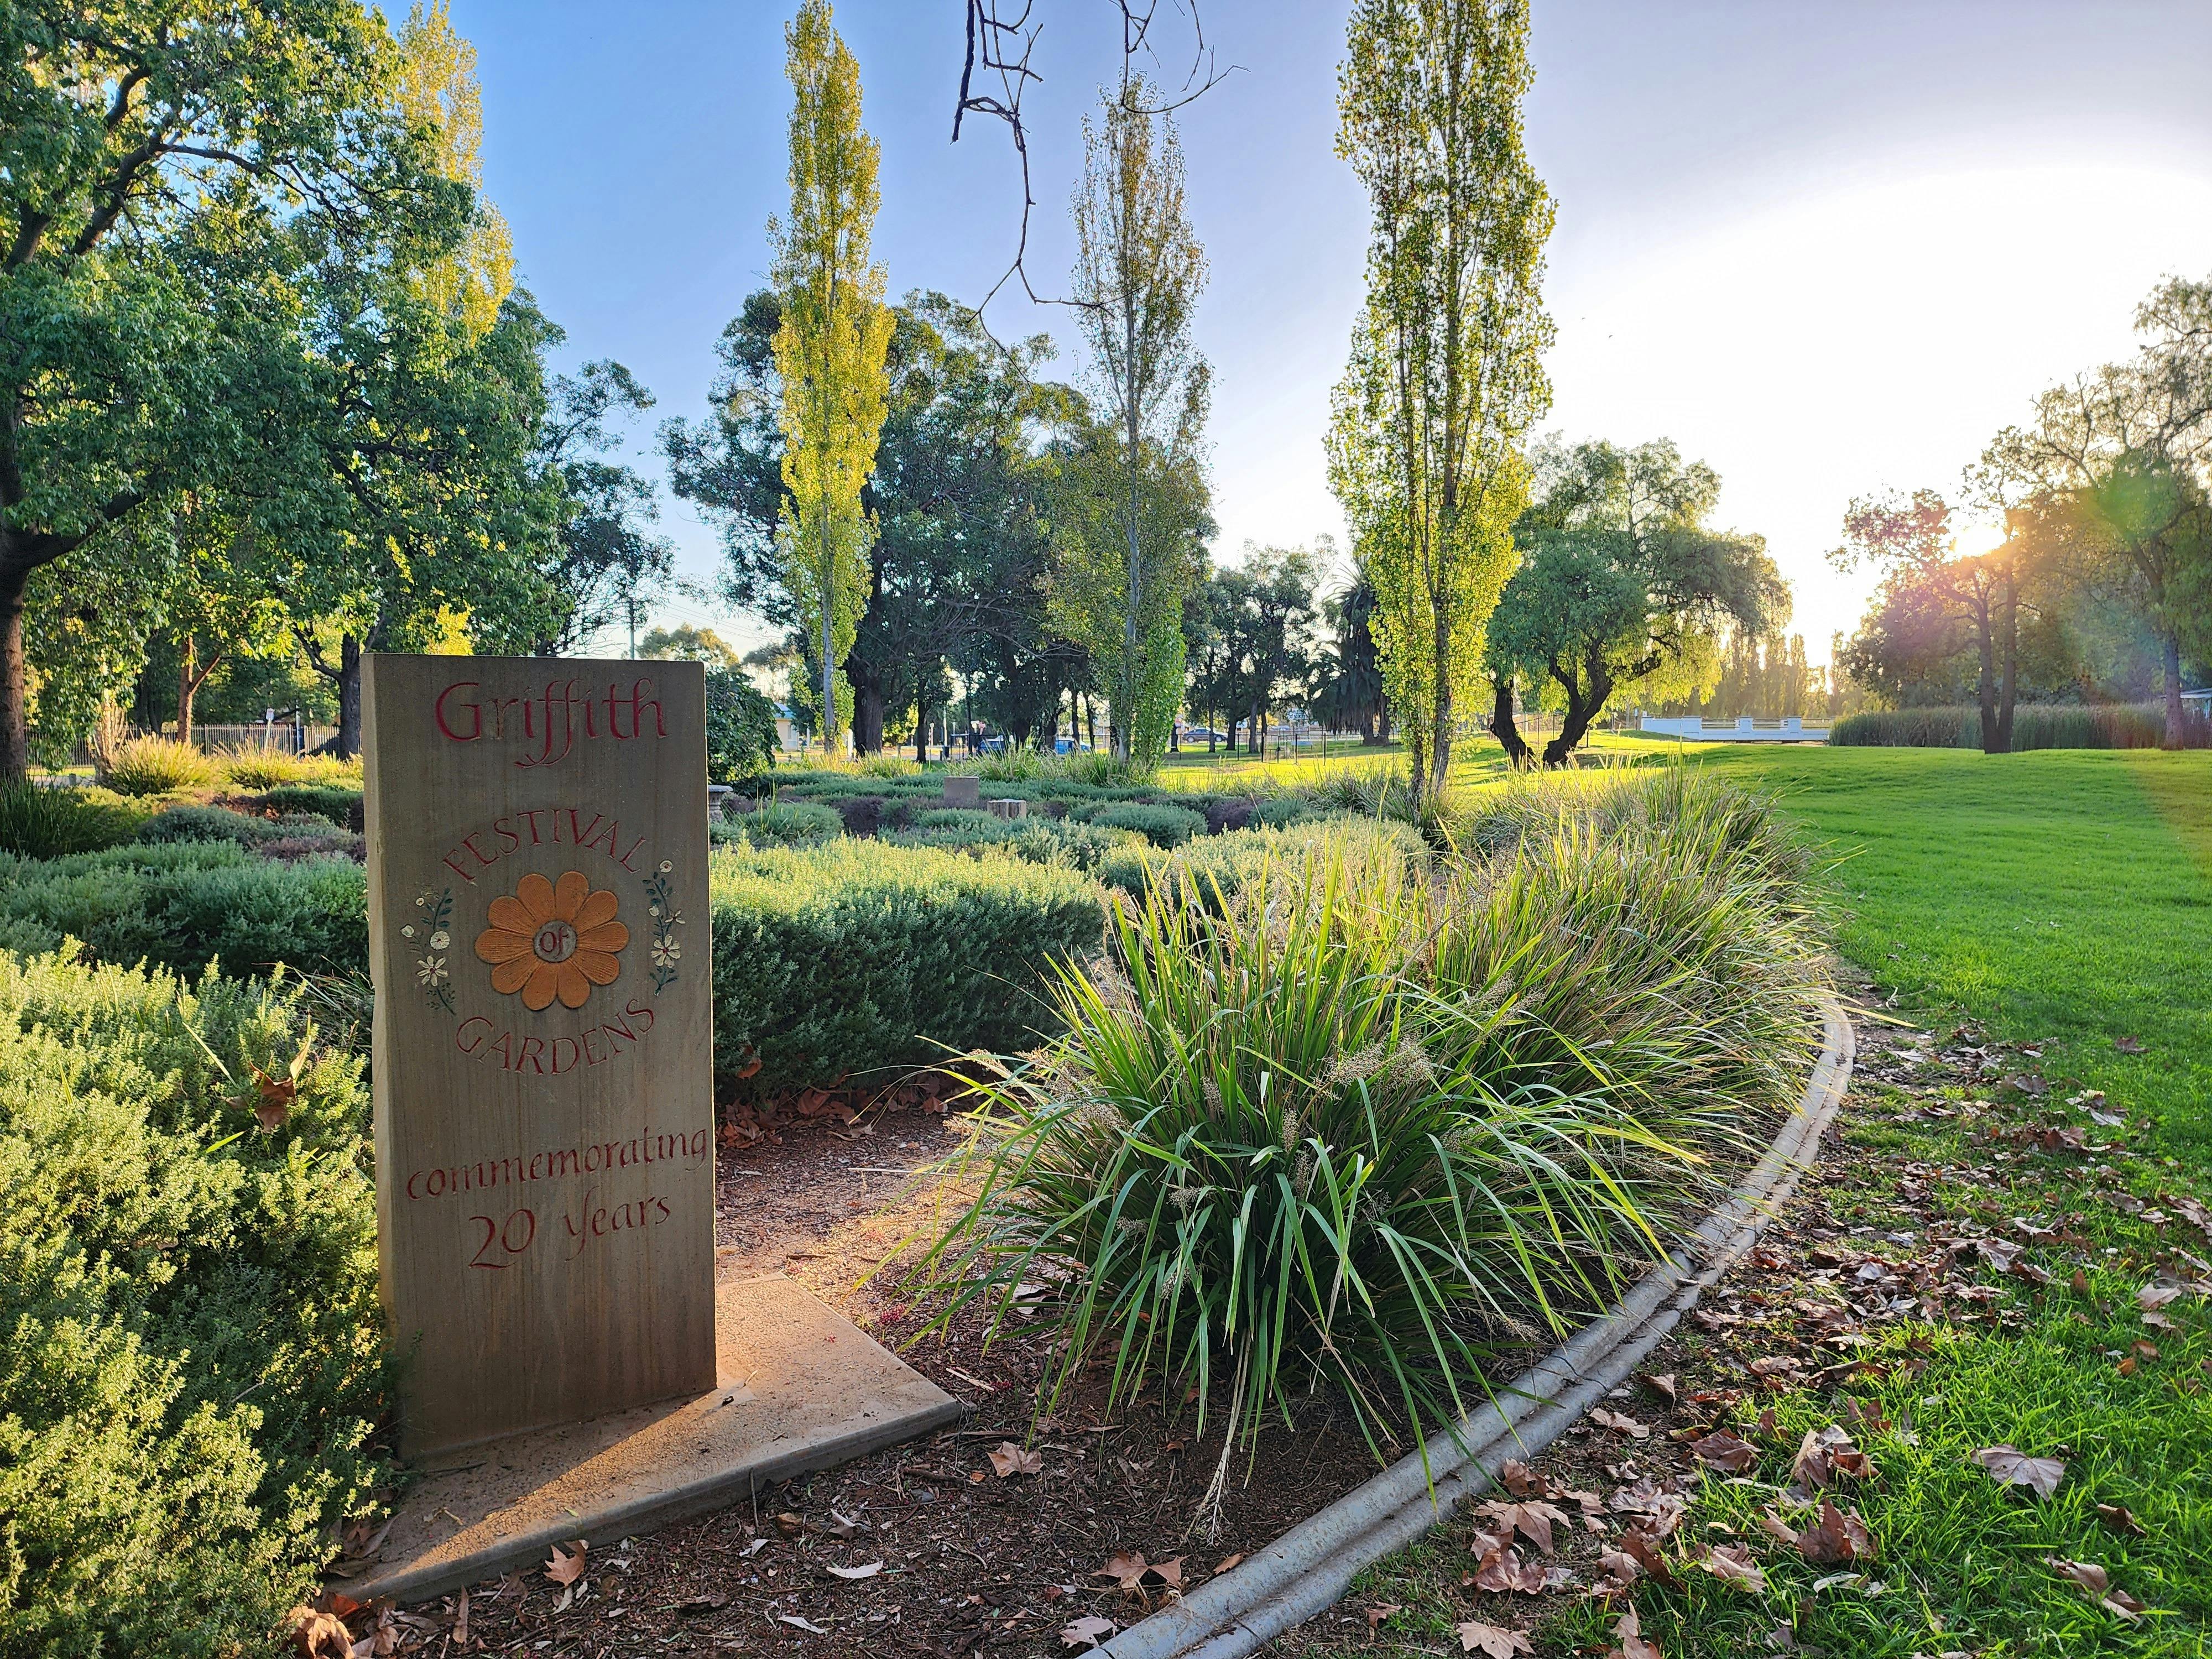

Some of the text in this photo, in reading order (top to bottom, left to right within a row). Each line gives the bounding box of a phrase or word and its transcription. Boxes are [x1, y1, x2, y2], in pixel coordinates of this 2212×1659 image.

[435, 678, 670, 768] Griffith
[442, 809, 646, 885] FESTIVAL
[455, 999, 654, 1074] GARDENS
[406, 1126, 707, 1200] commemorating
[468, 1209, 535, 1269] 20
